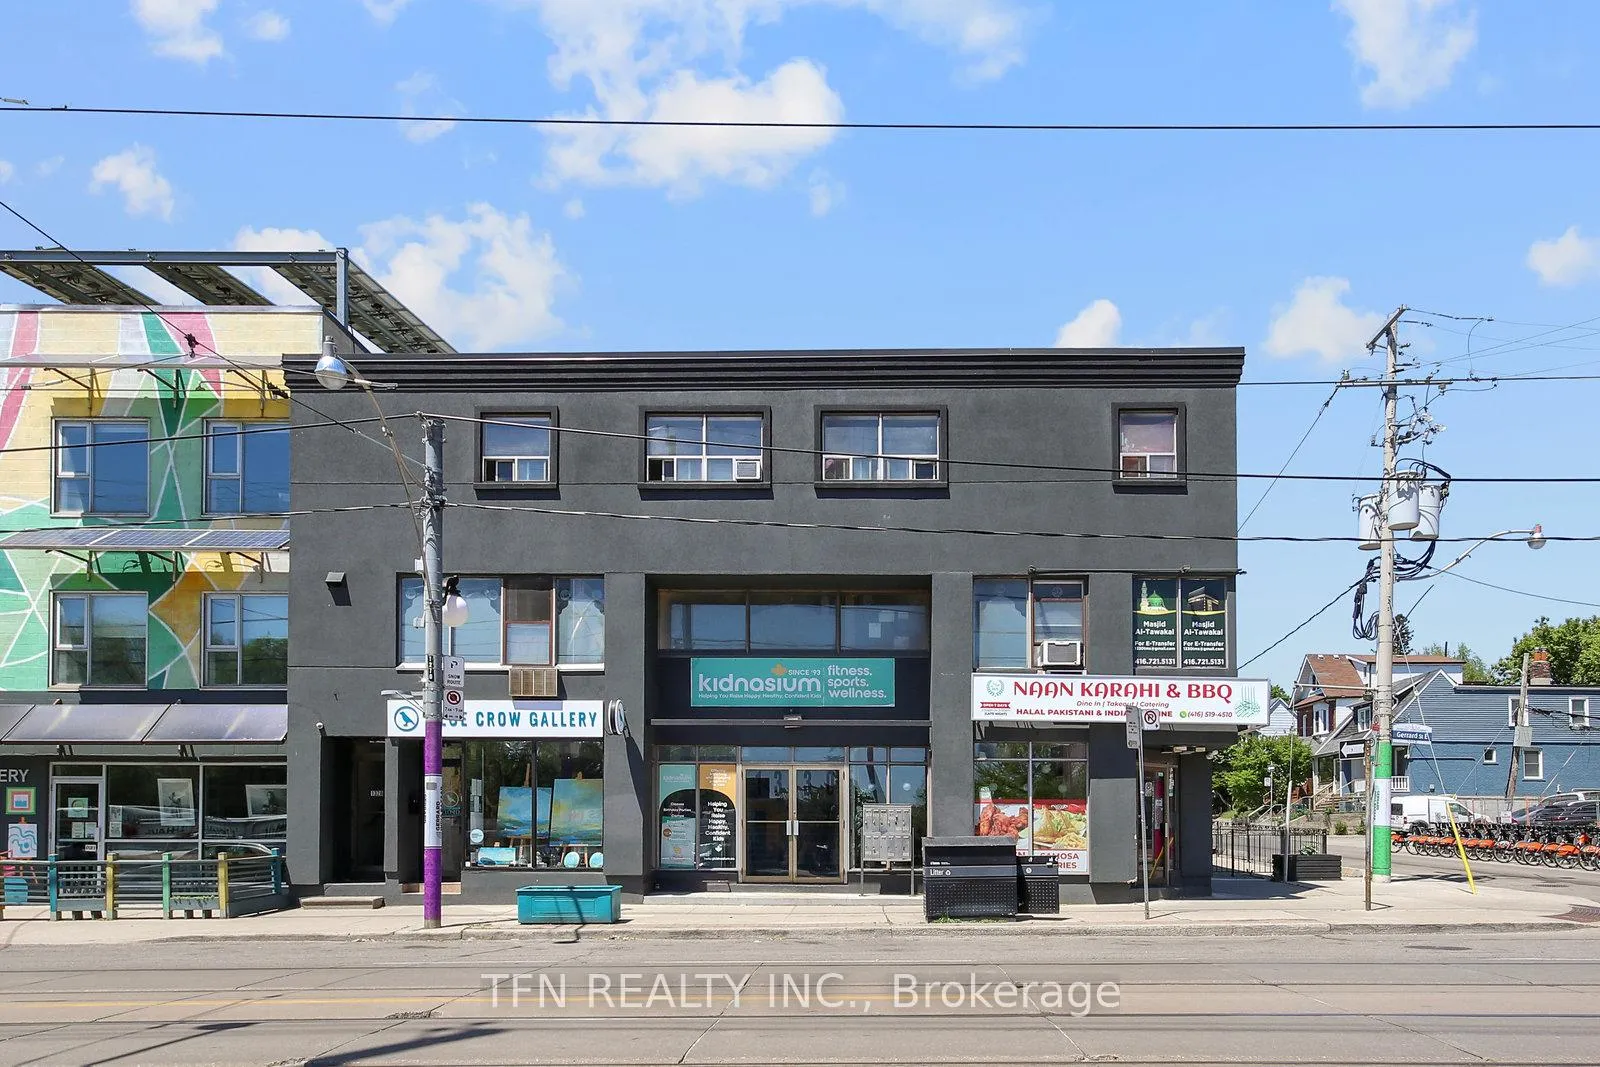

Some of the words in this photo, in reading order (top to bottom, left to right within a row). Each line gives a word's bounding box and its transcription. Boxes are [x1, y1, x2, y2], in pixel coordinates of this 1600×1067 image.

[828, 665, 872, 676] fitness.
[698, 674, 821, 692] kidnasium
[828, 677, 869, 688] sports.
[828, 688, 887, 698] wellness.
[1014, 681, 1073, 698] NAAN
[1081, 682, 1160, 699] KARAHI
[1167, 684, 1181, 698] &
[1188, 684, 1232, 703] BBQ
[476, 711, 520, 727] CROW
[530, 711, 597, 727] GALLERY
